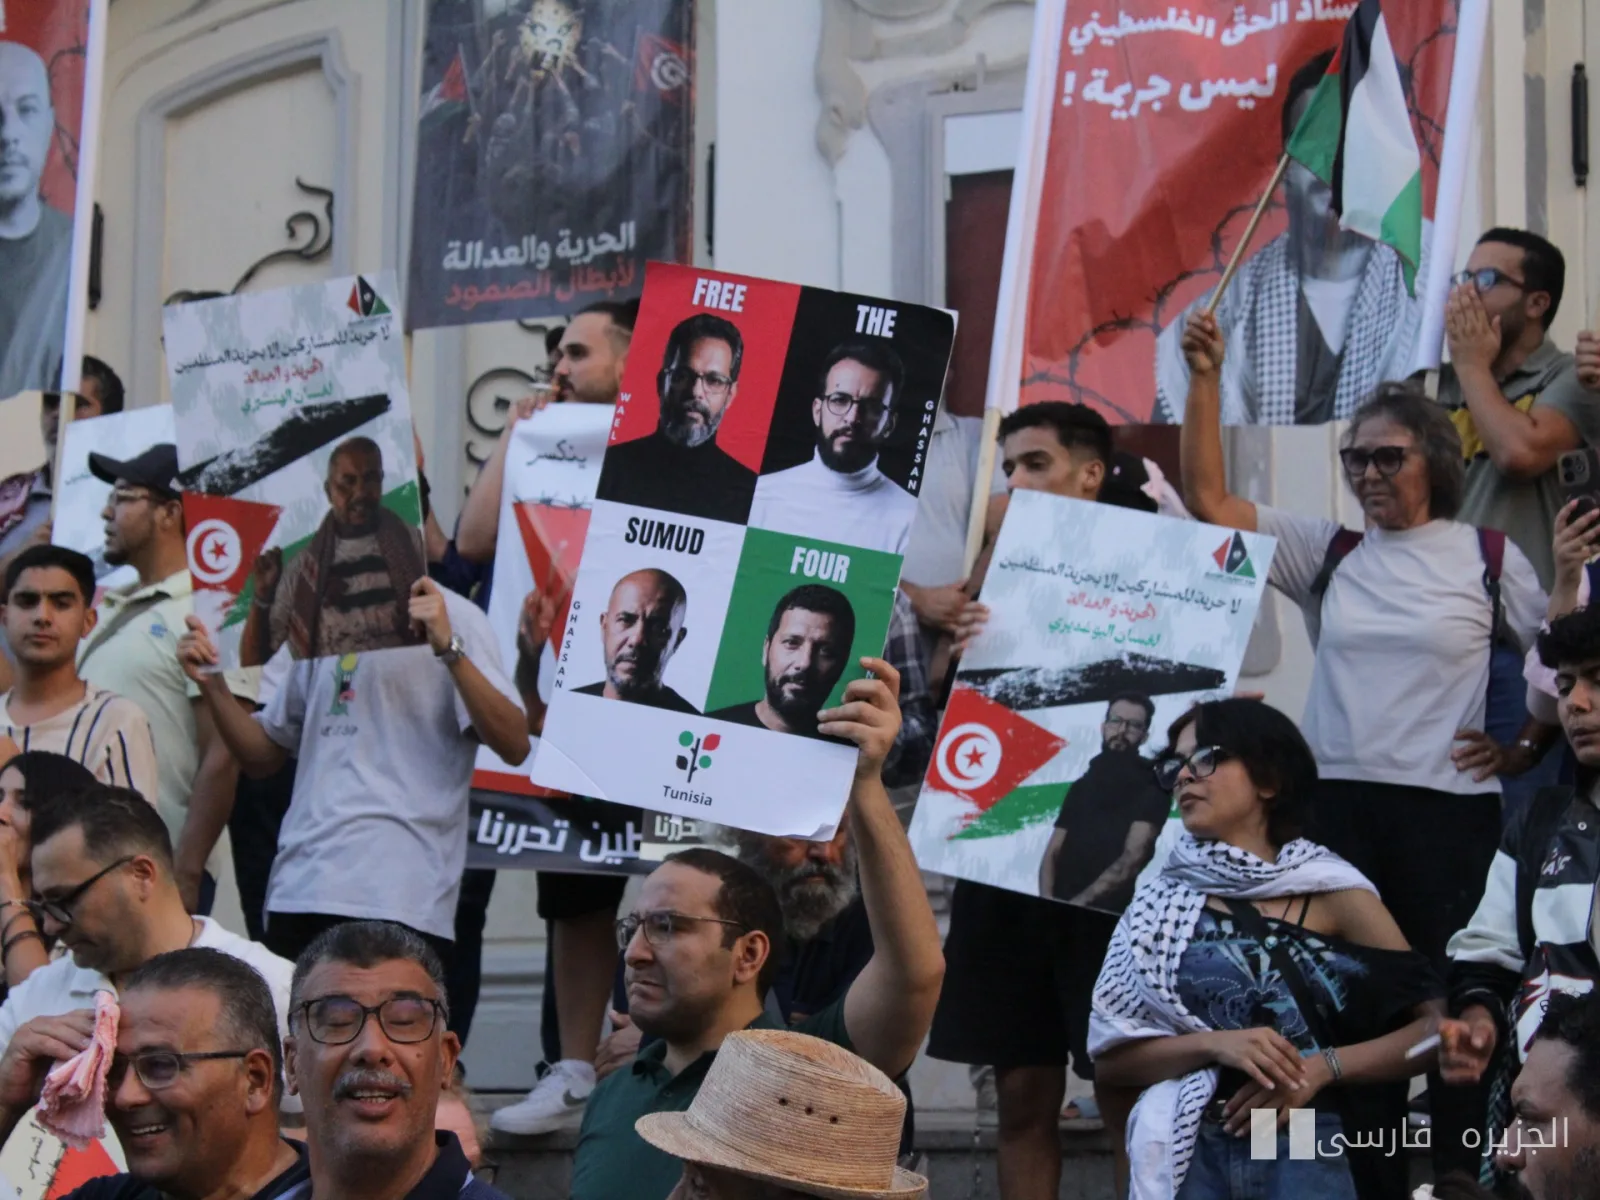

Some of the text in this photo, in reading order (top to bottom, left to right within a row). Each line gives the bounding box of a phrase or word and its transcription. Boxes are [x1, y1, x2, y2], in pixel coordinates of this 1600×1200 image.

[1068, 7, 1216, 55] الفلسطيني
[1179, 64, 1278, 111] ليس
[442, 220, 636, 271] الحرية والعدالة
[444, 269, 552, 311] الصمود
[692, 277, 898, 339] FREE THE
[611, 391, 631, 441] WAEL
[907, 400, 934, 491] GHASSAN
[624, 516, 851, 584] SUMUD FOUR
[1230, 599, 1242, 615] لا
[555, 601, 581, 689] GHASSAN
[662, 785, 713, 807] Tunisia
[476, 808, 570, 855] تحررنا
